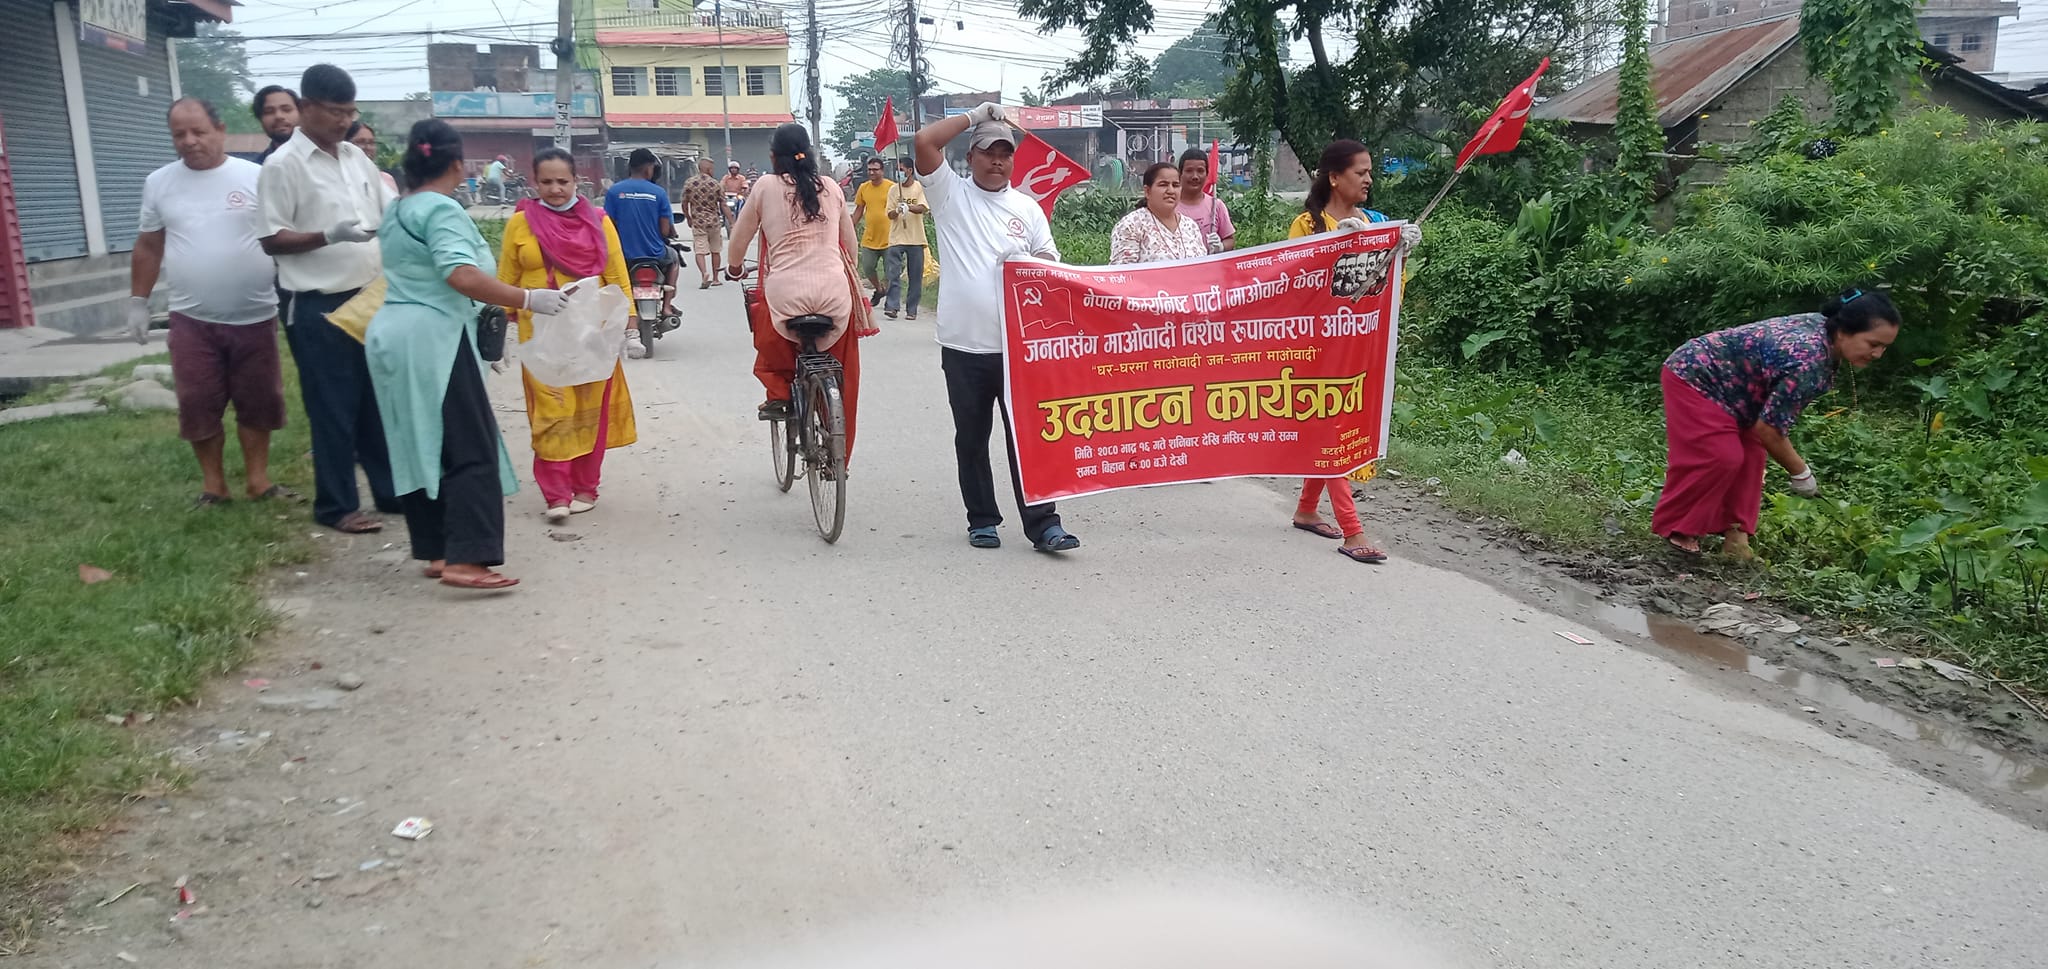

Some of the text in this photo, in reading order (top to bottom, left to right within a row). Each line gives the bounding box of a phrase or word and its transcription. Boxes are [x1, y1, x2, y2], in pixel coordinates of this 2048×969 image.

[1083, 287, 1122, 310] नेपाल
[1192, 284, 1221, 313] पार्टी
[1225, 272, 1290, 309] (माओवादी
[1023, 330, 1098, 362] जनतासँग
[1104, 321, 1176, 354] माओवादी
[1181, 317, 1225, 346] विशेष
[1321, 305, 1380, 338] अभियान
[1153, 352, 1202, 371] माओवादी
[1206, 350, 1262, 366] जन-जनमा
[1038, 367, 1368, 442] उदघाटन कार्यक्रम
[1097, 445, 1119, 457] २०८०
[1121, 442, 1137, 454] भाद्र
[1139, 441, 1151, 452] १६
[1153, 437, 1166, 451] गते
[1202, 431, 1220, 446] देखि
[1222, 430, 1246, 444] मंसिर
[1247, 431, 1259, 443] १५
[1262, 428, 1276, 442] गते
[1278, 431, 1299, 442] सम्म
[1321, 444, 1345, 456] कटहरी
[1169, 452, 1188, 466] देखी
